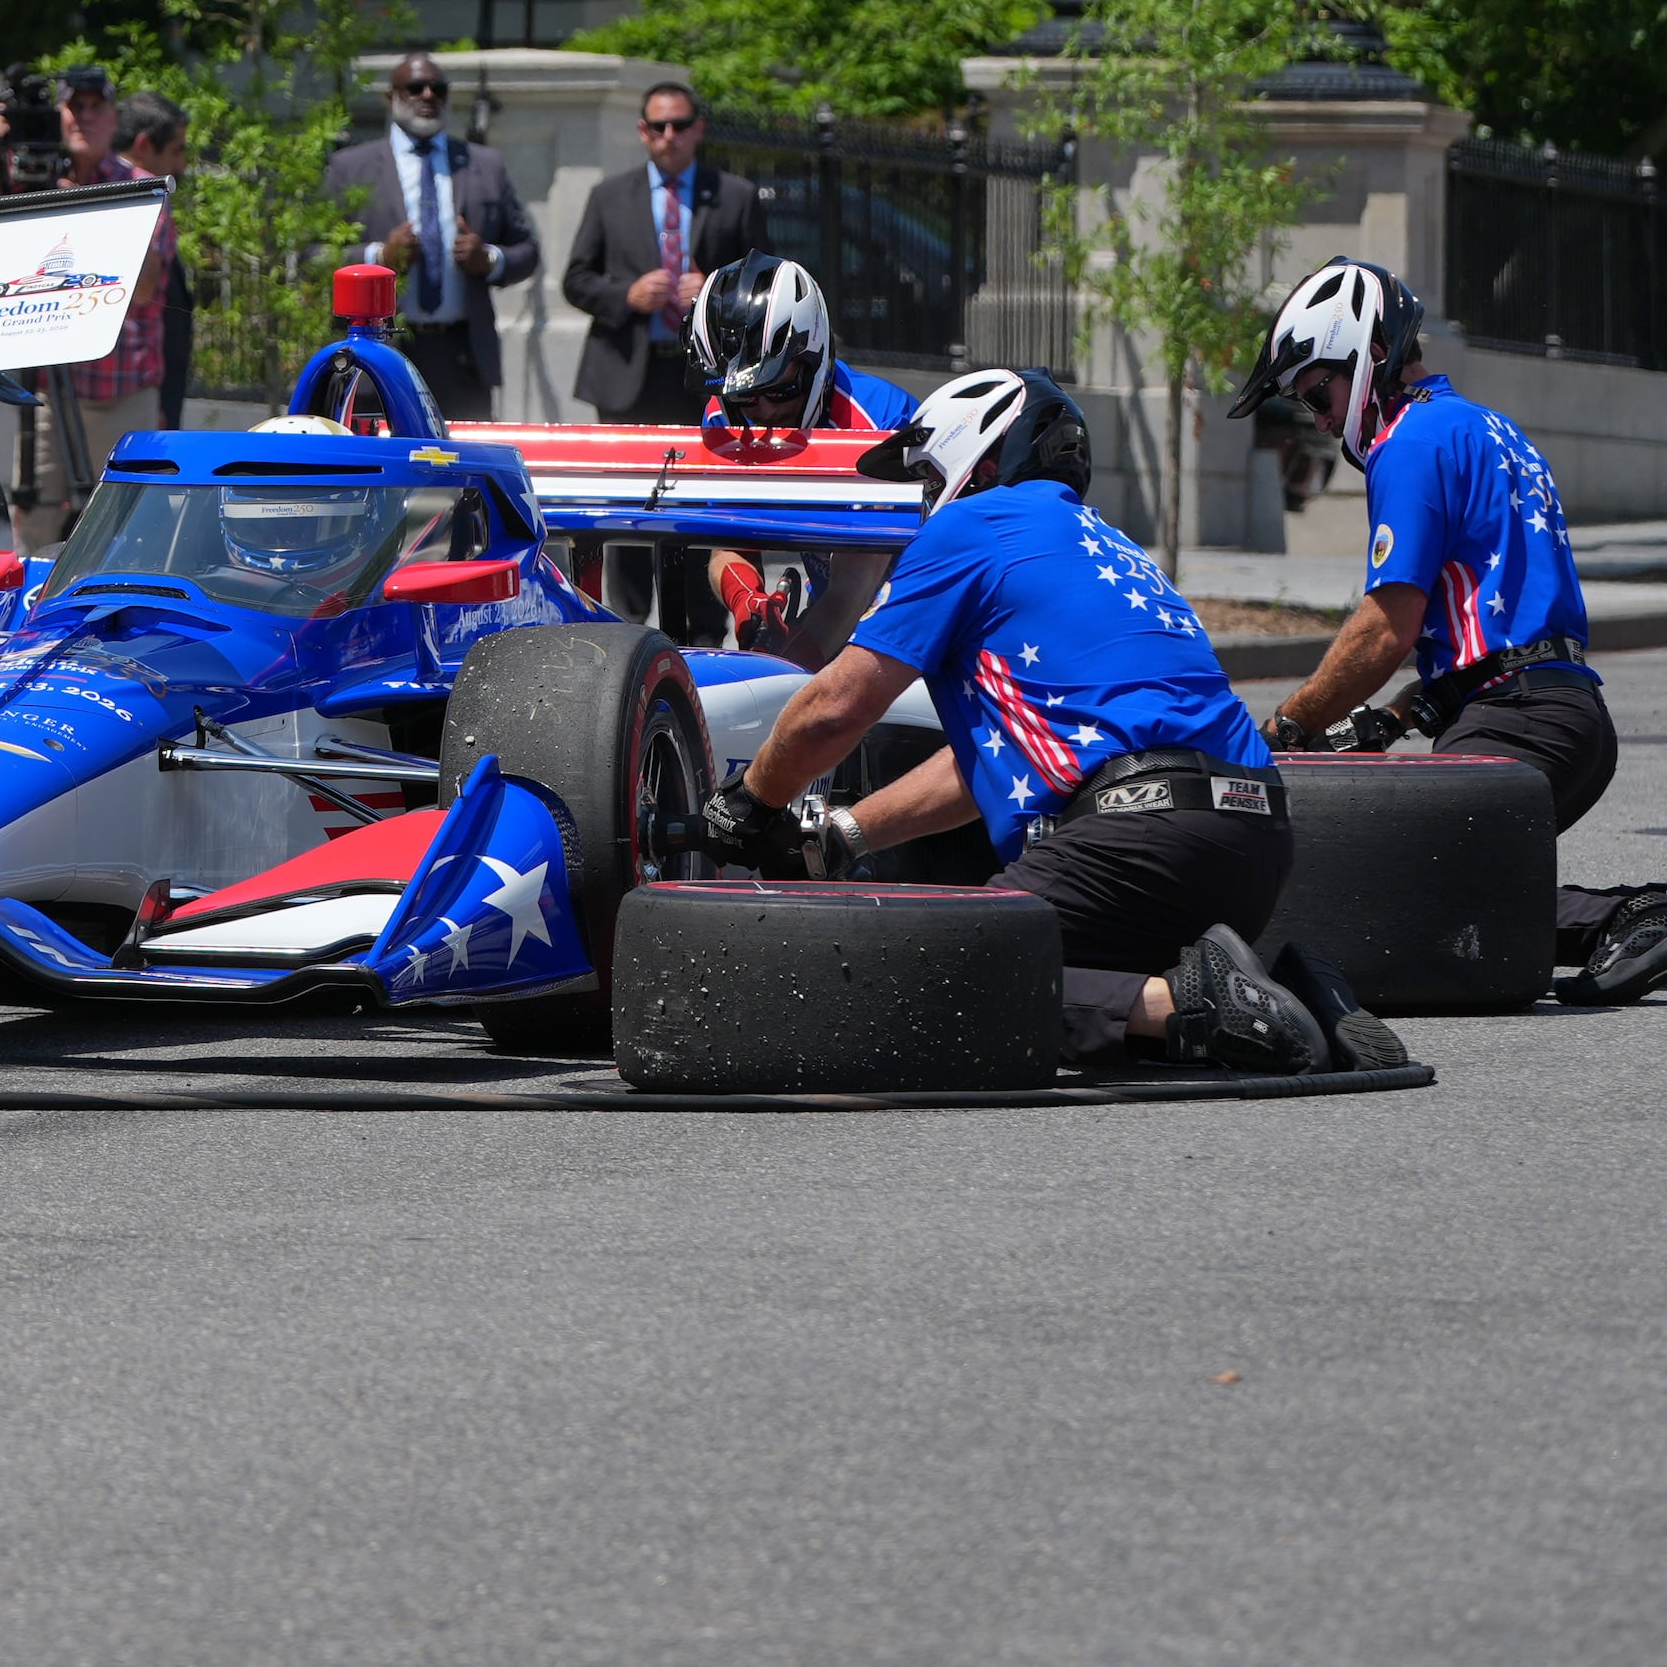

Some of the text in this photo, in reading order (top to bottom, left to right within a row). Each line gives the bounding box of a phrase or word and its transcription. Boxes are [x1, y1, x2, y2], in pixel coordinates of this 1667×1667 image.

[64, 287, 127, 316] 250
[2, 312, 72, 328] Grand Prix
[261, 504, 314, 514] Freedom 250
[458, 607, 492, 631] August
[511, 598, 538, 623] 2026
[61, 686, 134, 722] 2026
[1227, 780, 1261, 795] TEAM
[1144, 797, 1171, 809] WEAR
[1219, 794, 1268, 811] PENSKE
